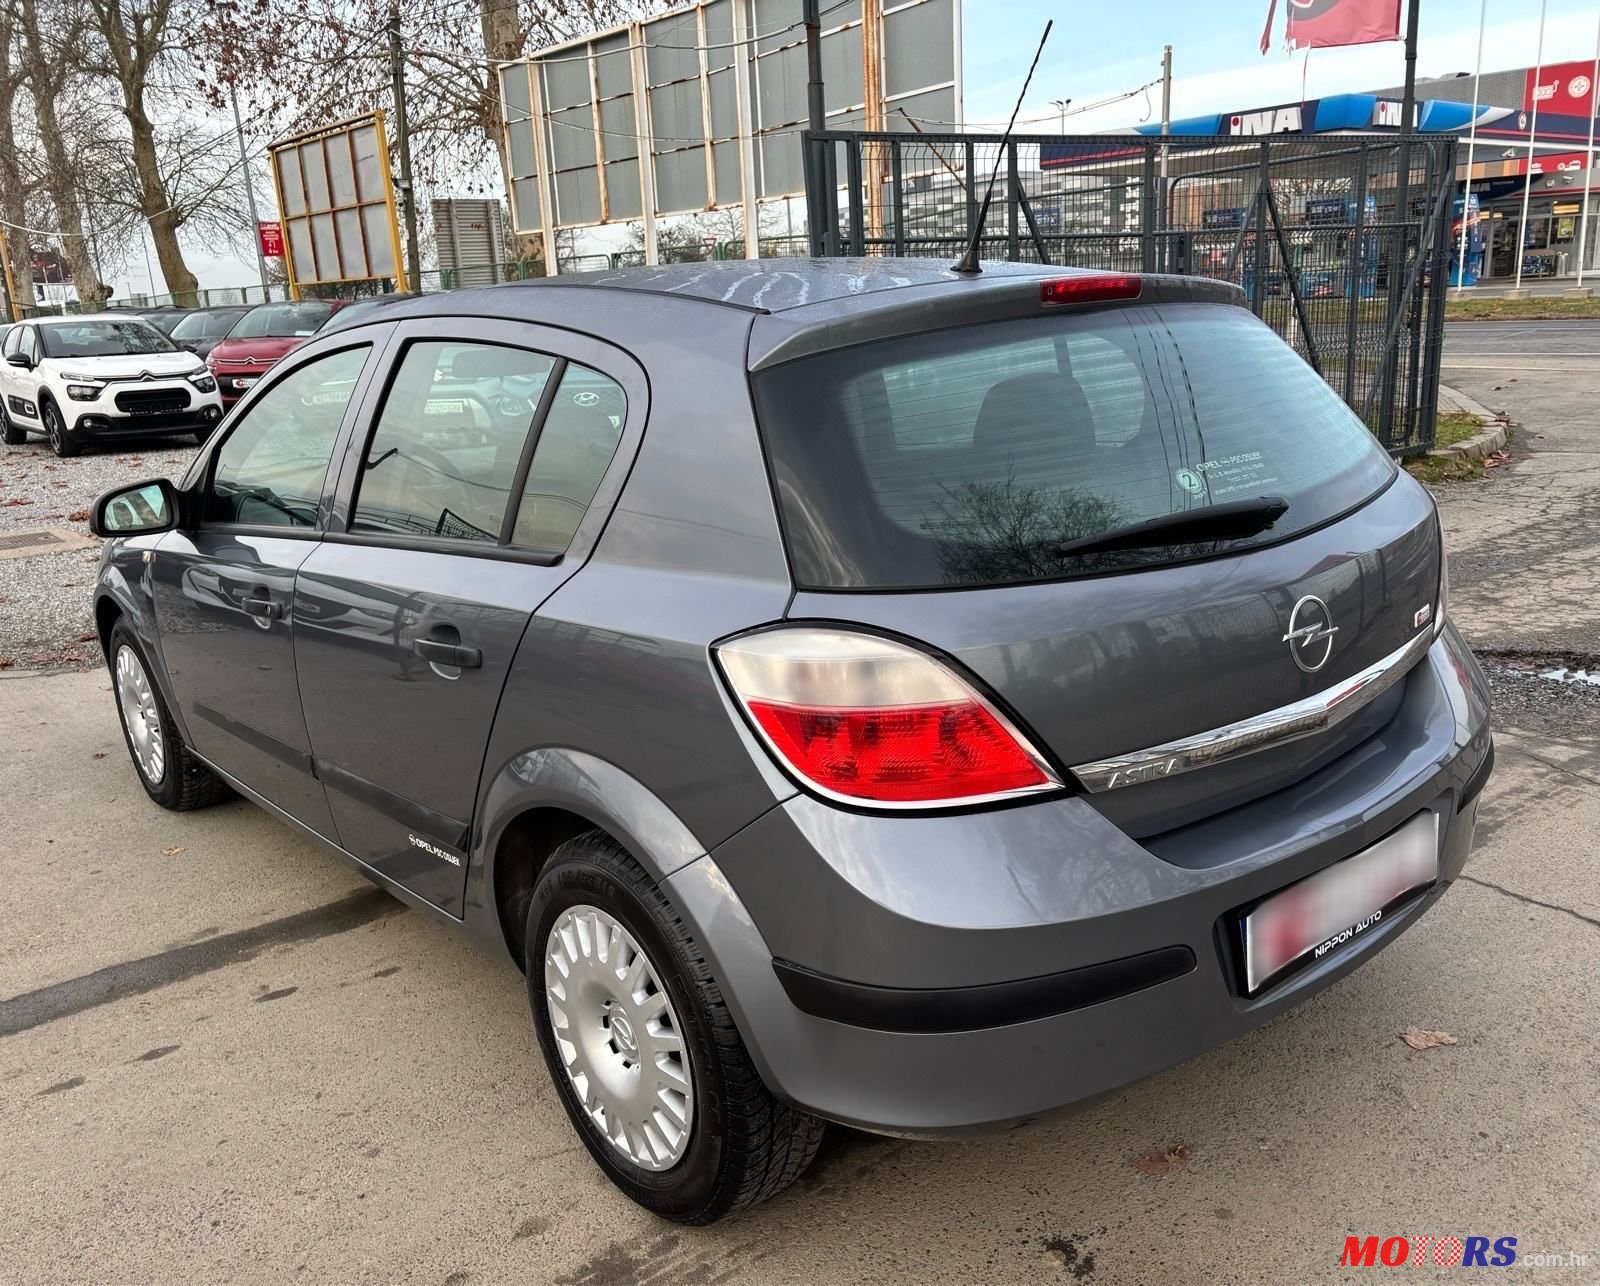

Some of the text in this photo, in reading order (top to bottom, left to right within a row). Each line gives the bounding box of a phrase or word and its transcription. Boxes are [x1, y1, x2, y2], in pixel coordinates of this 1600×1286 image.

[1196, 460, 1222, 471] OPEL
[1108, 758, 1178, 788] ASTRA
[415, 838, 434, 854] OPEL
[1315, 910, 1382, 958] NIPPON AUTO
